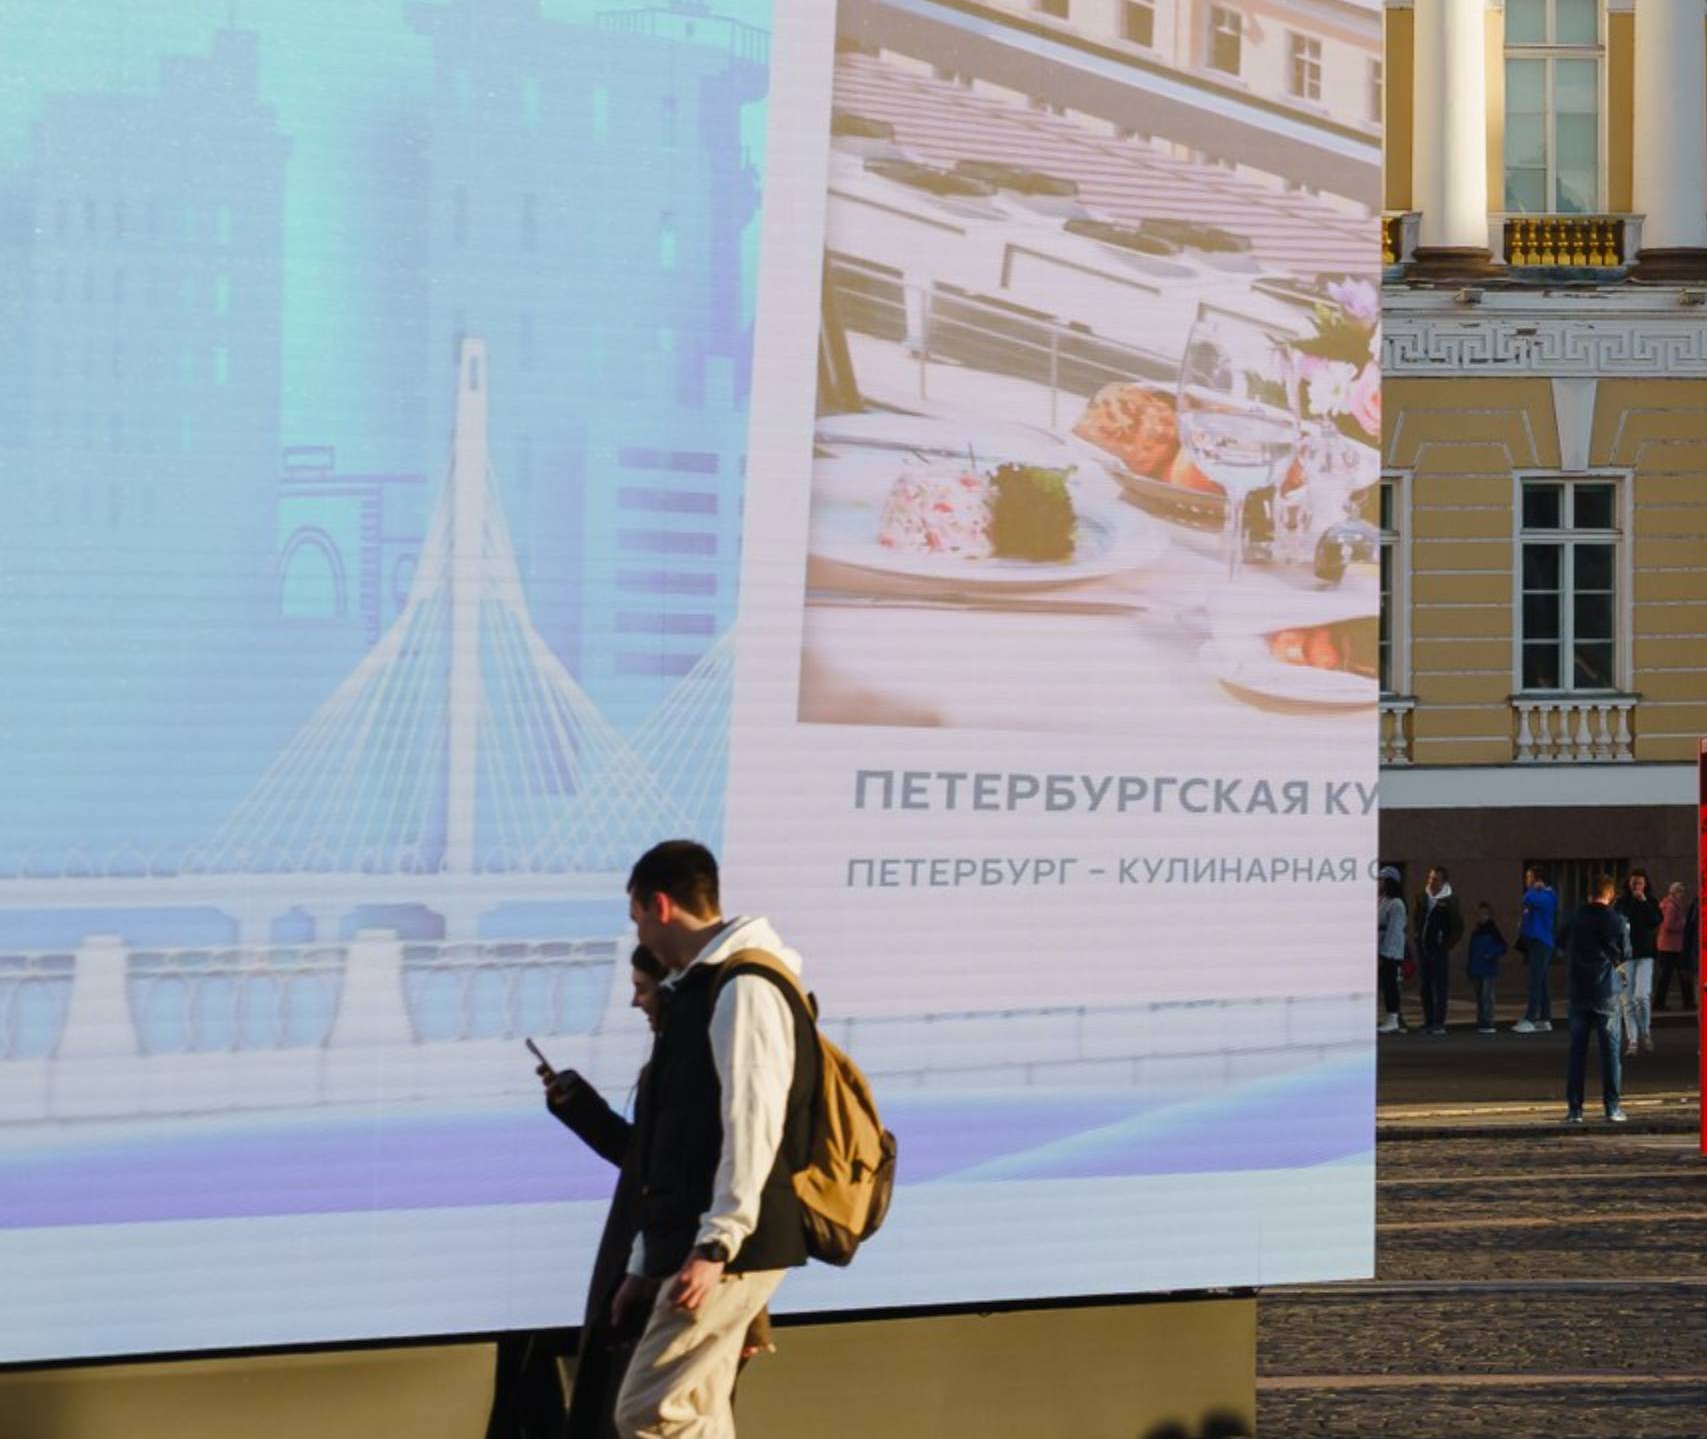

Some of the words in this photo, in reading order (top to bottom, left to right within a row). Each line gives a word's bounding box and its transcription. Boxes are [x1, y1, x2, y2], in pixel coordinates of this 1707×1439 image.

[853, 769, 1309, 816] ПЕТЕРБУРГСКАЯ
[1324, 780, 1378, 816] КУ
[846, 857, 1079, 889] ПЕТЕРБУРГ
[1117, 857, 1357, 886] КУЛИНАРНАЯ
